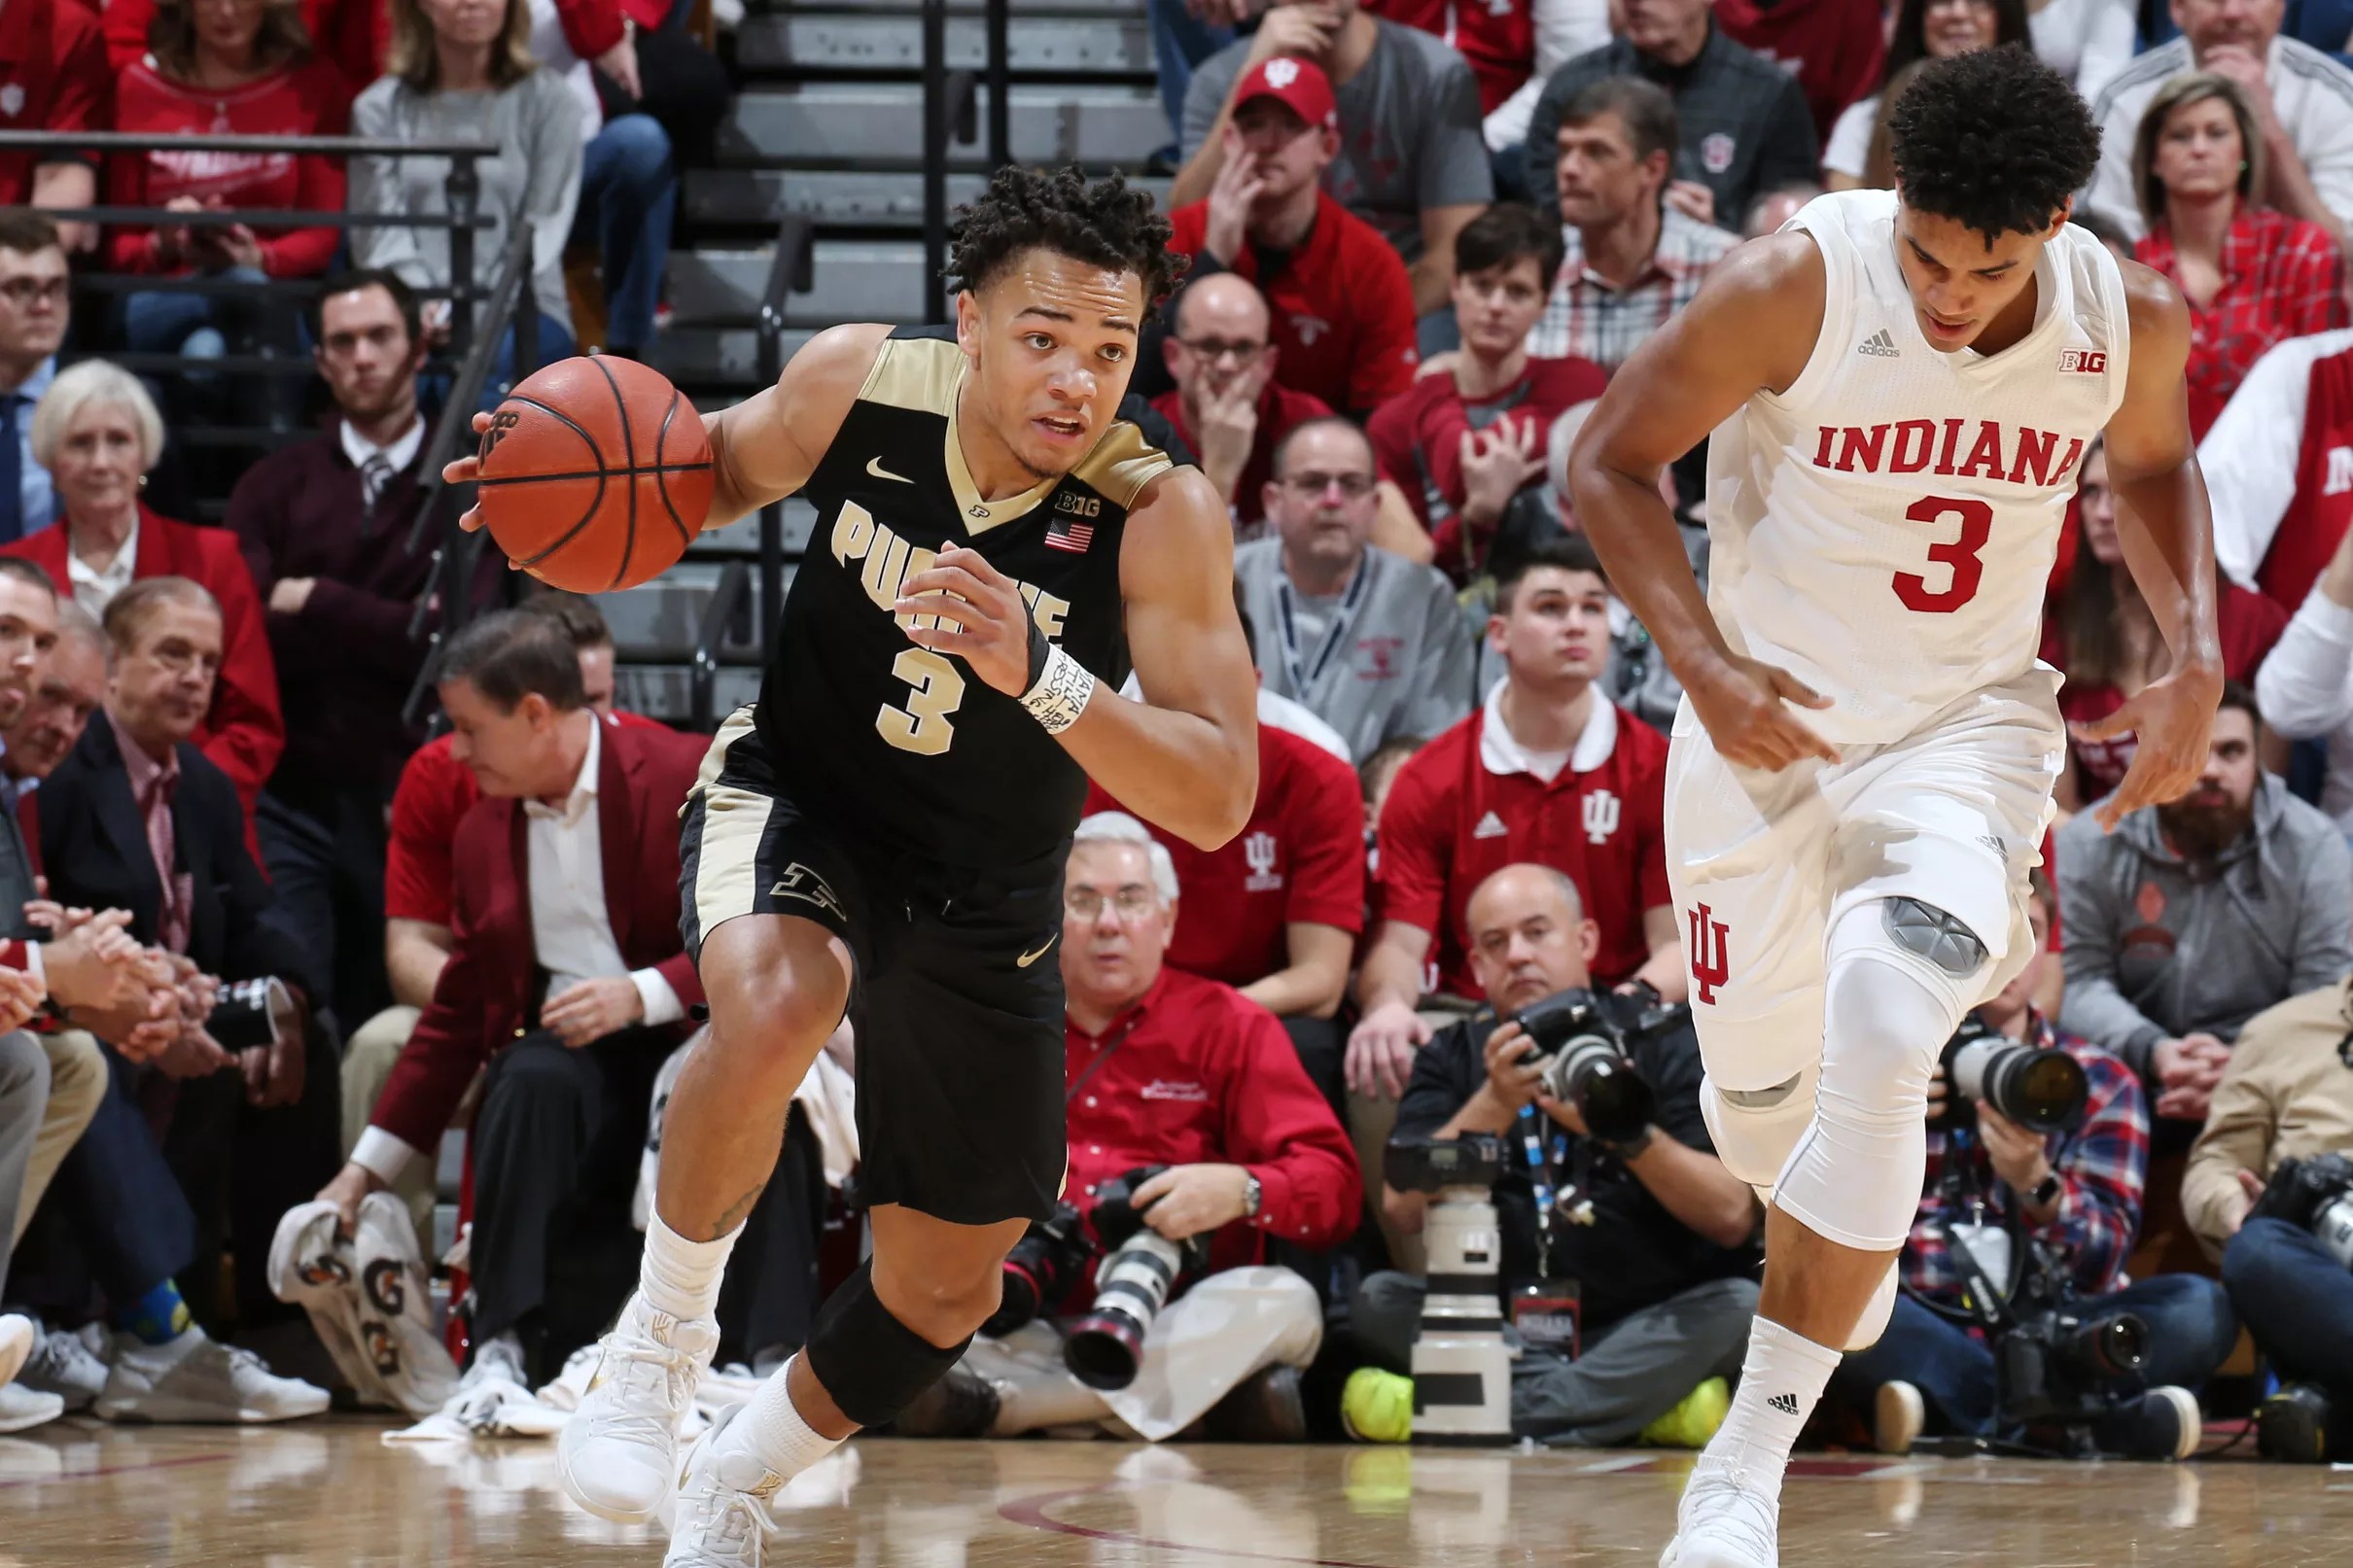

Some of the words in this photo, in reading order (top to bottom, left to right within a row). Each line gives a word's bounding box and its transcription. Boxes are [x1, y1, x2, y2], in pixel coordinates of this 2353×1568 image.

[1892, 495, 1993, 612] 3
[875, 646, 966, 755] 3
[1581, 788, 1622, 846] IU
[1687, 900, 1730, 1006] IU
